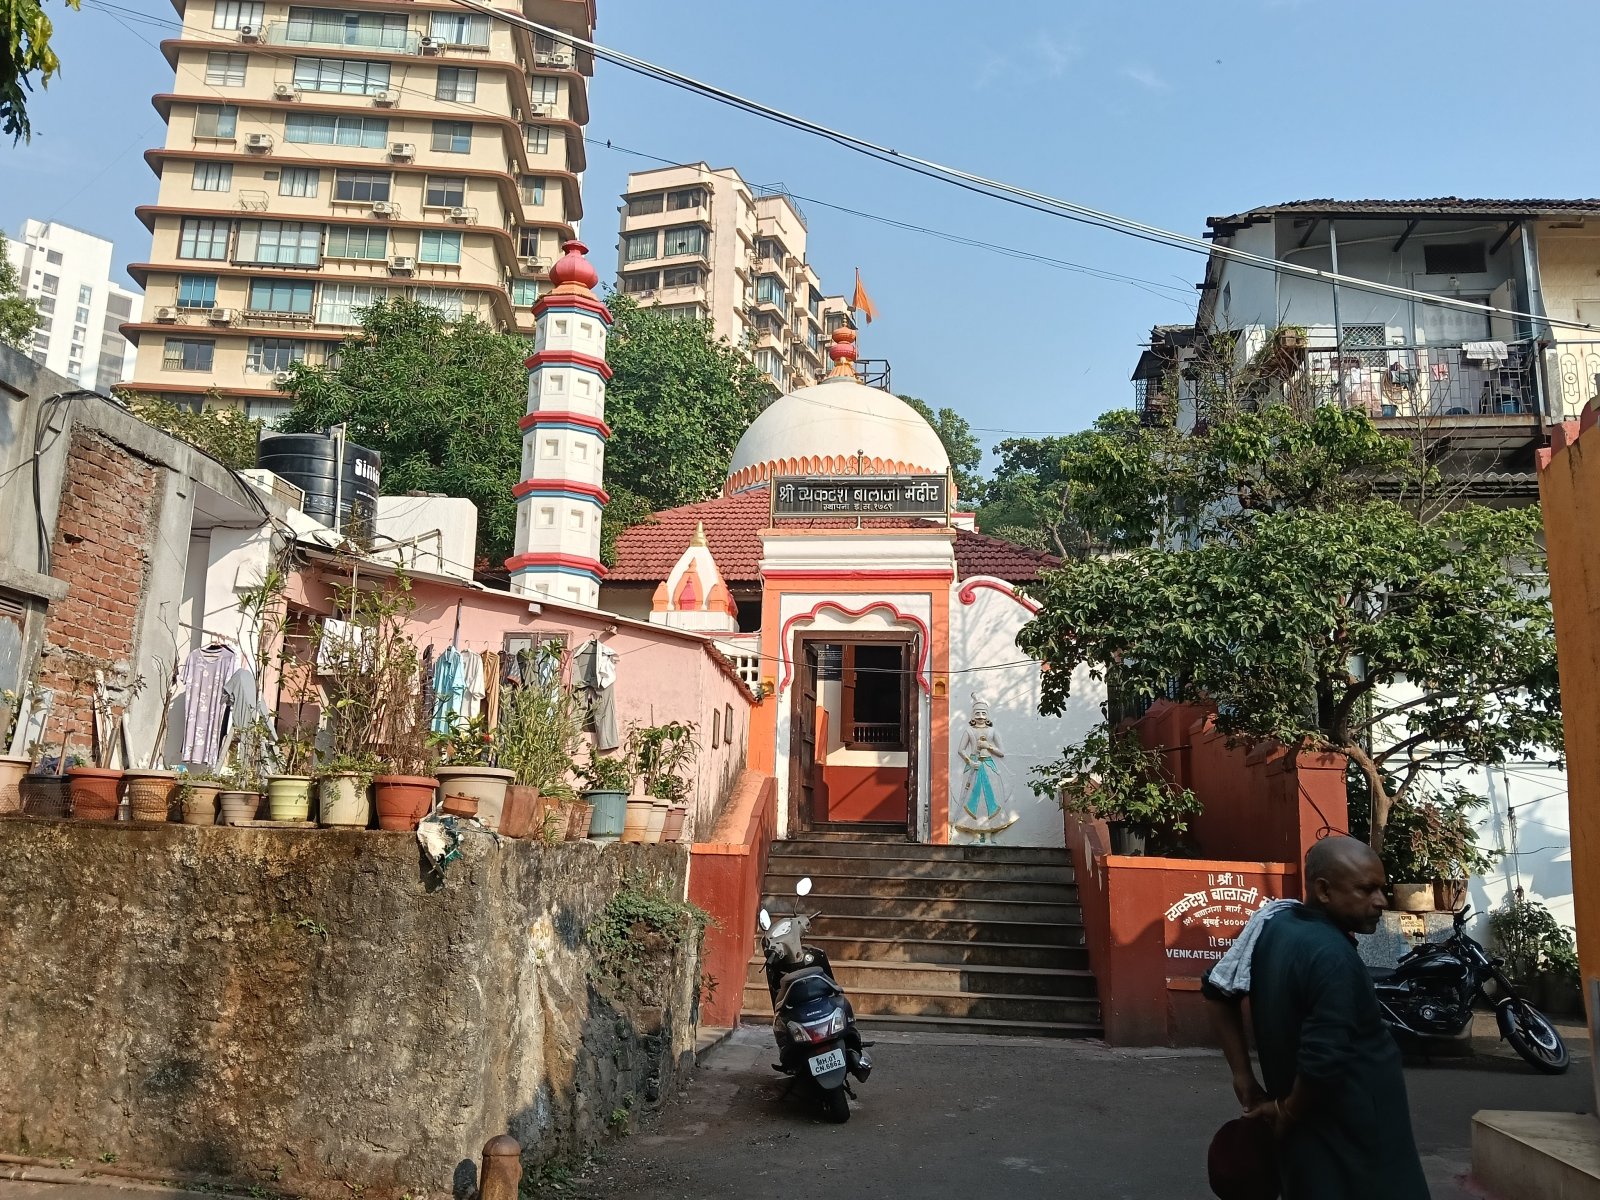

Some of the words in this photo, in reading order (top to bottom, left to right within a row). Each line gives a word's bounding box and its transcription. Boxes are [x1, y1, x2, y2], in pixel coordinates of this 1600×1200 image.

[779, 483, 795, 503] श्री
[823, 503, 851, 511] स्थापना
[1217, 872, 1234, 886] श्री
[1210, 887, 1258, 904] बालाजी
[1165, 948, 1222, 960] VENKATESH
